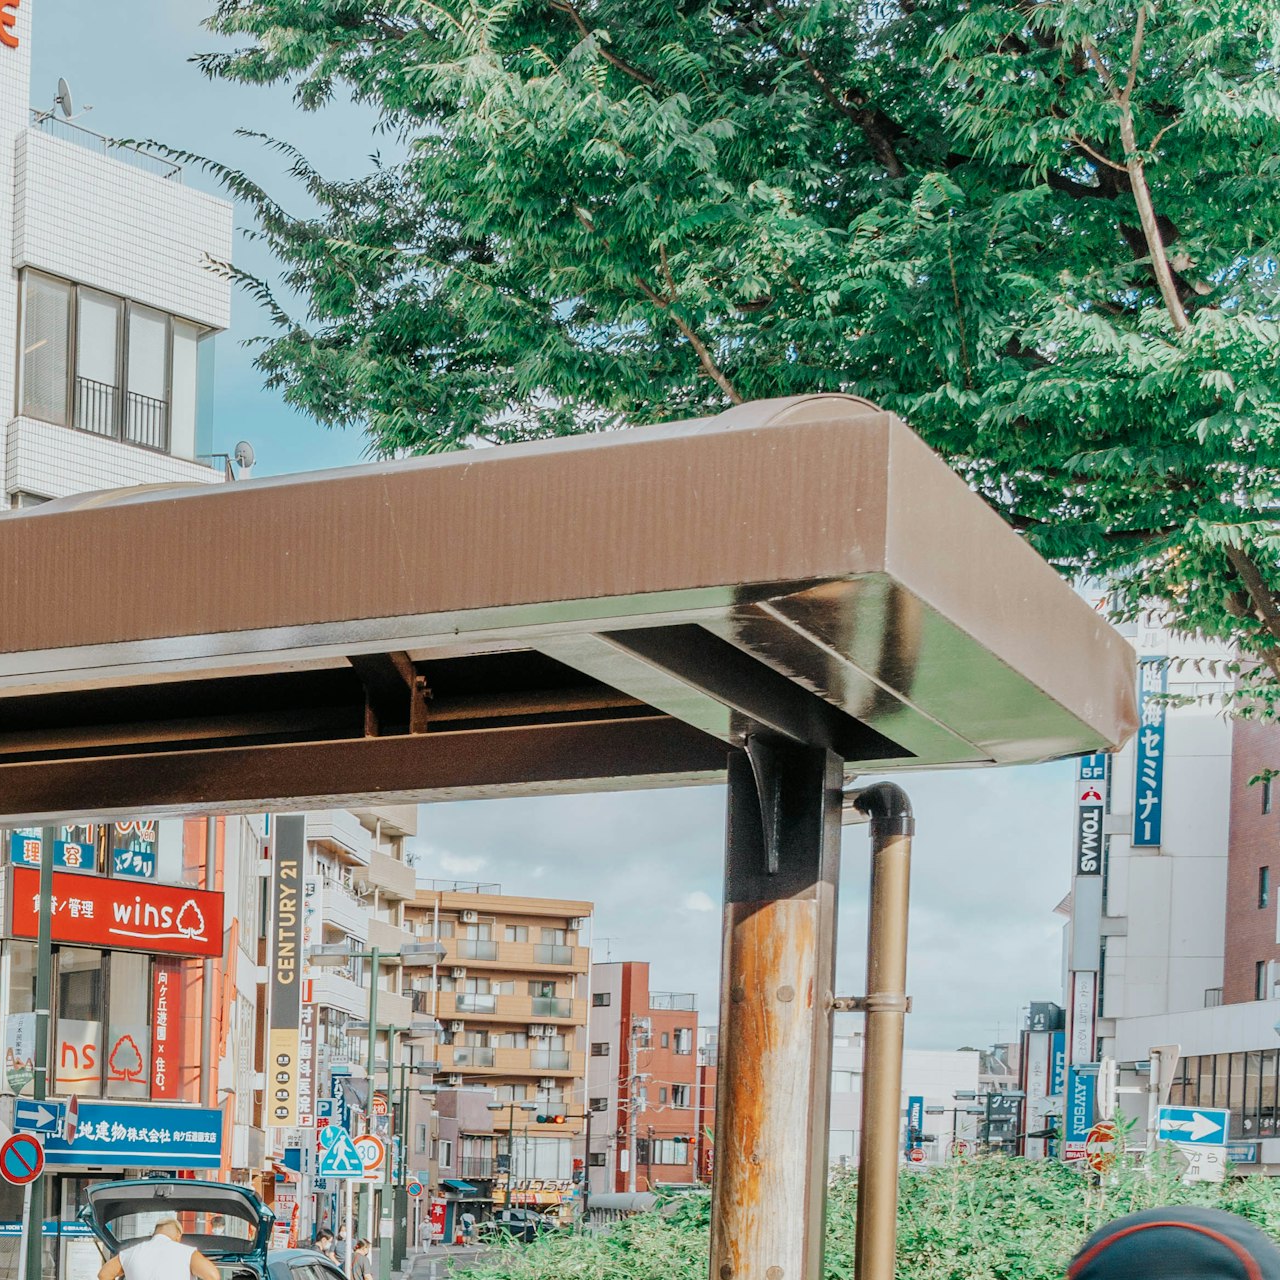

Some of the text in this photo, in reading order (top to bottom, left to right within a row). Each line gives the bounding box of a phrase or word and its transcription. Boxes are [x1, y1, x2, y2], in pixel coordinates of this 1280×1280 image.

[1081, 767, 1103, 779] 5F
[1080, 808, 1099, 873] TOMAS
[112, 895, 173, 929] wins
[277, 860, 298, 985] CENTURY 21
[318, 1102, 330, 1117] P
[1073, 1075, 1087, 1136] LAWSON
[127, 1126, 171, 1144] 株式会社
[358, 1145, 377, 1161] 30
